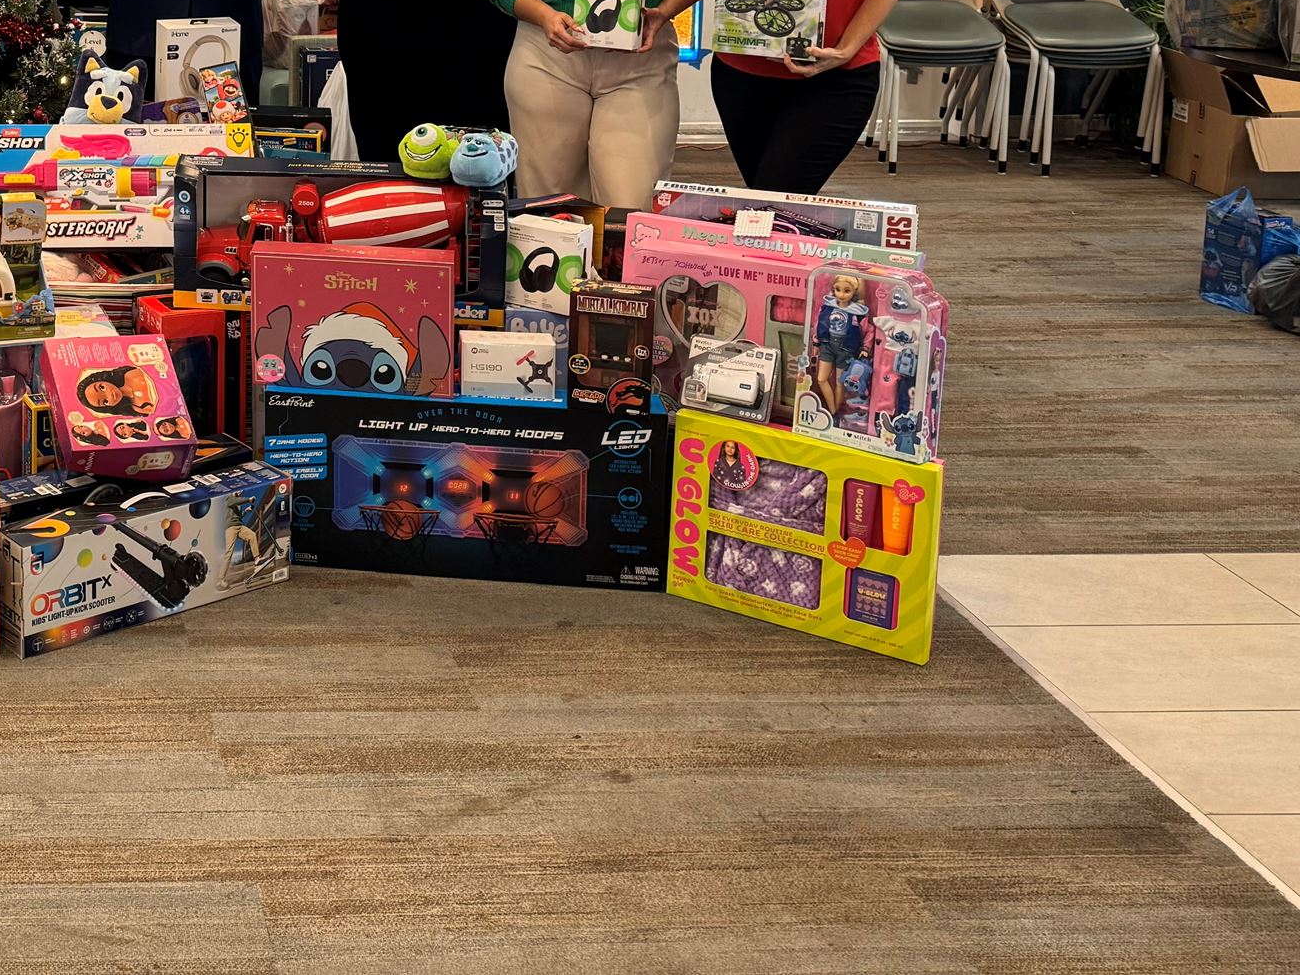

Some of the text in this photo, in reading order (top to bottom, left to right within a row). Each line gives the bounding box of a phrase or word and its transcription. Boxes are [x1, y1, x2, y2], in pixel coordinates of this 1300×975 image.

[717, 36, 766, 47] GAMMA
[179, 206, 190, 215] 4+
[681, 225, 729, 247] Mega
[797, 240, 854, 260] World
[767, 273, 801, 287] BEAUTY
[577, 295, 649, 318] MORTAL KOMBAT
[268, 395, 316, 408] EastPoint
[417, 407, 504, 424] OVER THE DOOR
[801, 410, 818, 425] ily
[358, 419, 564, 441] LIGHT UP HEAD-TO-HEAD HOOPS
[601, 428, 652, 446] LED
[269, 438, 276, 446] 7
[269, 450, 324, 459] HEAD-TO-HEAD
[722, 515, 758, 529] EVERYDAY
[709, 518, 825, 553] SKIN CARE COLLECTION
[47, 609, 75, 622] LIGHT-UP
[74, 606, 89, 616] KICK
[89, 596, 116, 609] SCOOTER
